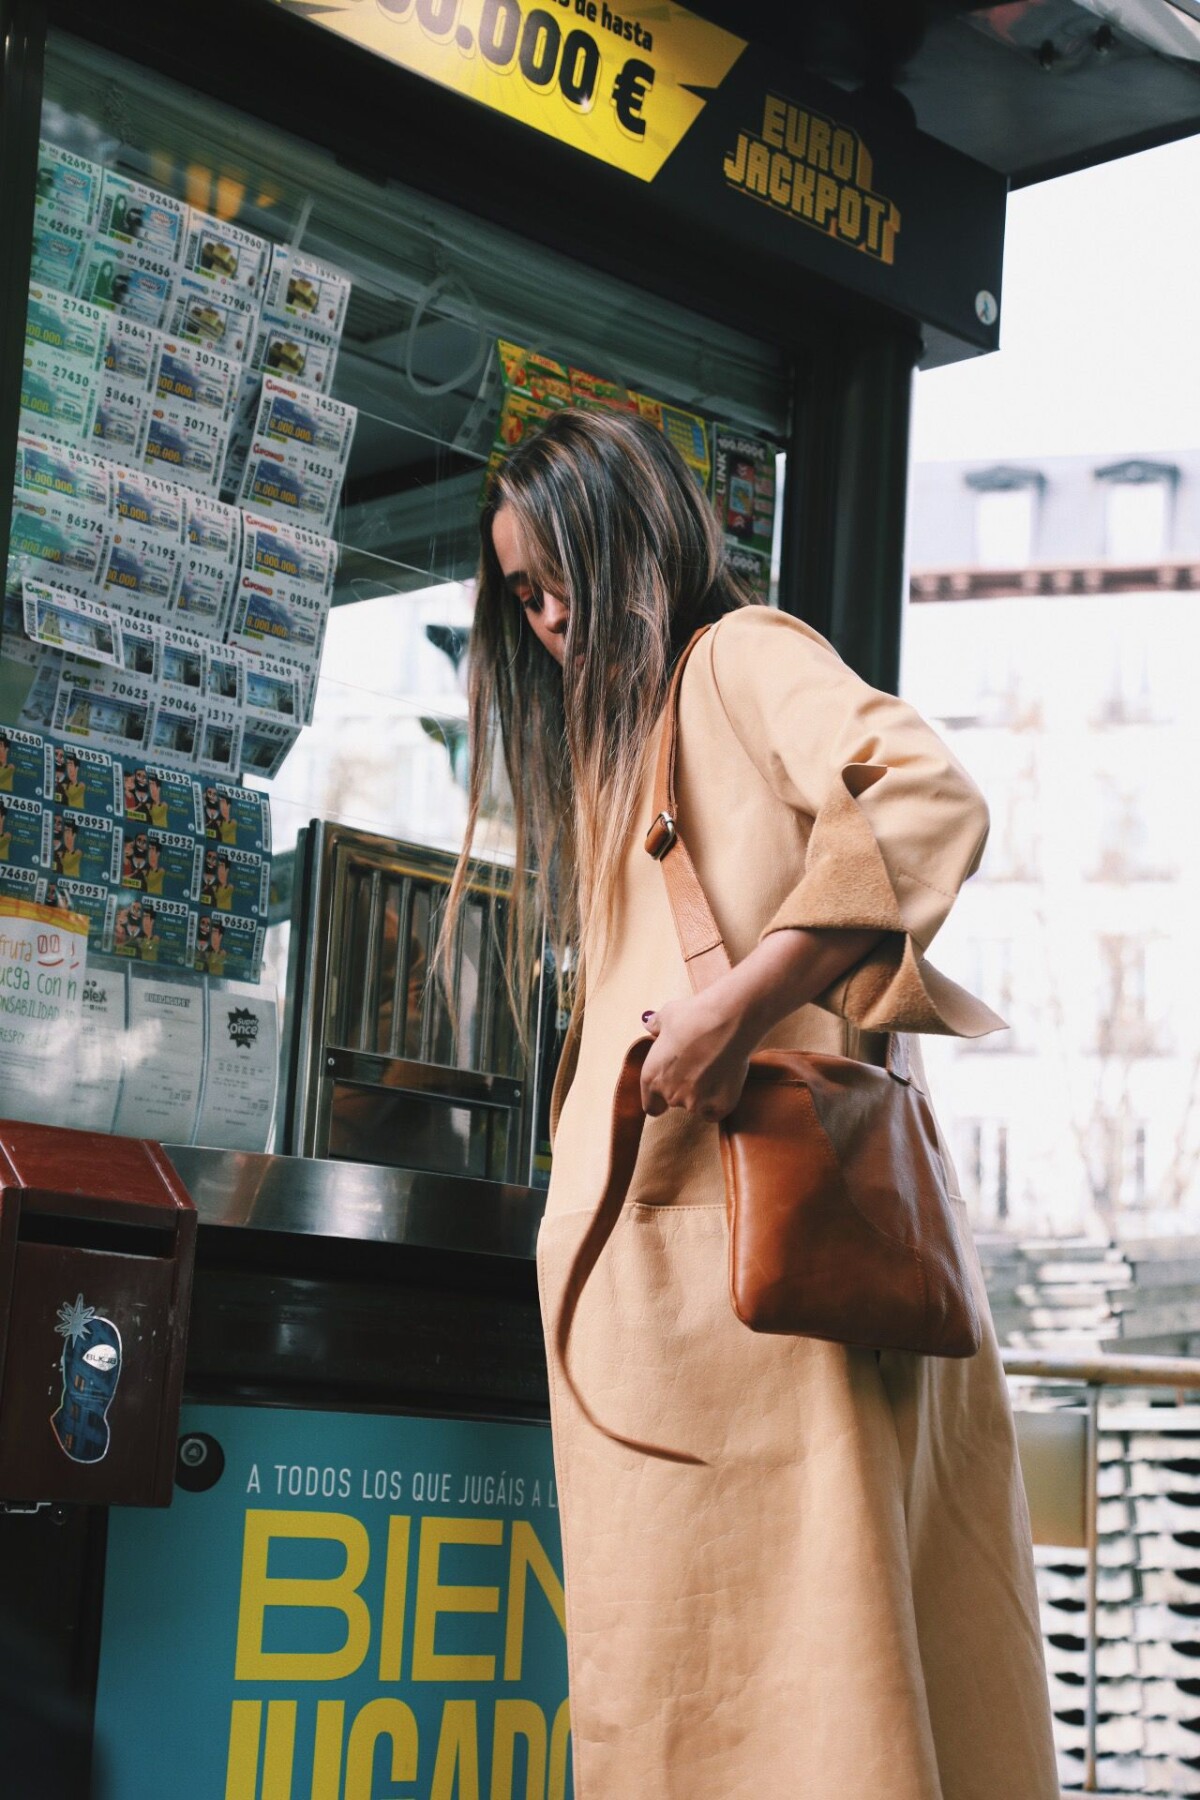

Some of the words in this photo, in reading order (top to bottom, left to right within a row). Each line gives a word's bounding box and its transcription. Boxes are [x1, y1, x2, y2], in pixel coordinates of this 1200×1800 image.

[601, 2, 654, 52] hasta
[611, 58, 656, 136] €
[763, 94, 860, 182] EURO
[149, 192, 180, 212] 92456
[724, 129, 892, 262] JACKPOT
[49, 219, 83, 240] 42695
[232, 230, 262, 250] 27960
[138, 257, 170, 277] 92456
[63, 299, 100, 320] 27430
[221, 294, 251, 313] 27960
[195, 351, 229, 373] 30712
[52, 365, 89, 387] 27430
[105, 387, 141, 408] 58641
[315, 397, 346, 417] 14523
[184, 416, 219, 437] 30712
[68, 448, 105, 469] 86574
[303, 460, 333, 479] 14523
[716, 453, 727, 495] LINK
[144, 477, 179, 497] 74195
[66, 512, 103, 534] 86574
[141, 540, 176, 561] 74195
[189, 560, 224, 580] 91786
[73, 599, 109, 618] 15704
[289, 593, 320, 611] 08569
[164, 631, 199, 648] 29046
[259, 660, 292, 677] 32489
[111, 682, 148, 700] 70625
[161, 696, 197, 713] 29046
[9, 730, 42, 748] 74680
[77, 749, 111, 766] 98951
[158, 769, 190, 786] 58932
[227, 787, 259, 803] 96563
[6, 797, 41, 814] 74680
[77, 815, 111, 831] 98951
[161, 833, 193, 849] 58932
[229, 851, 260, 867] 96563
[0, 866, 36, 882] 74680
[71, 884, 106, 898] 98951
[155, 900, 187, 917] 58932
[224, 917, 255, 932] 96563
[229, 1024, 258, 1036] Once
[237, 1017, 259, 1028] Super
[247, 1464, 260, 1494] A
[274, 1465, 352, 1498] TODOS
[363, 1469, 402, 1500] LOS
[413, 1473, 451, 1503] QUE
[458, 1470, 524, 1508] JUGÁIS
[532, 1479, 541, 1507] A
[548, 1480, 558, 1508] L
[234, 1508, 567, 1682] BIEN
